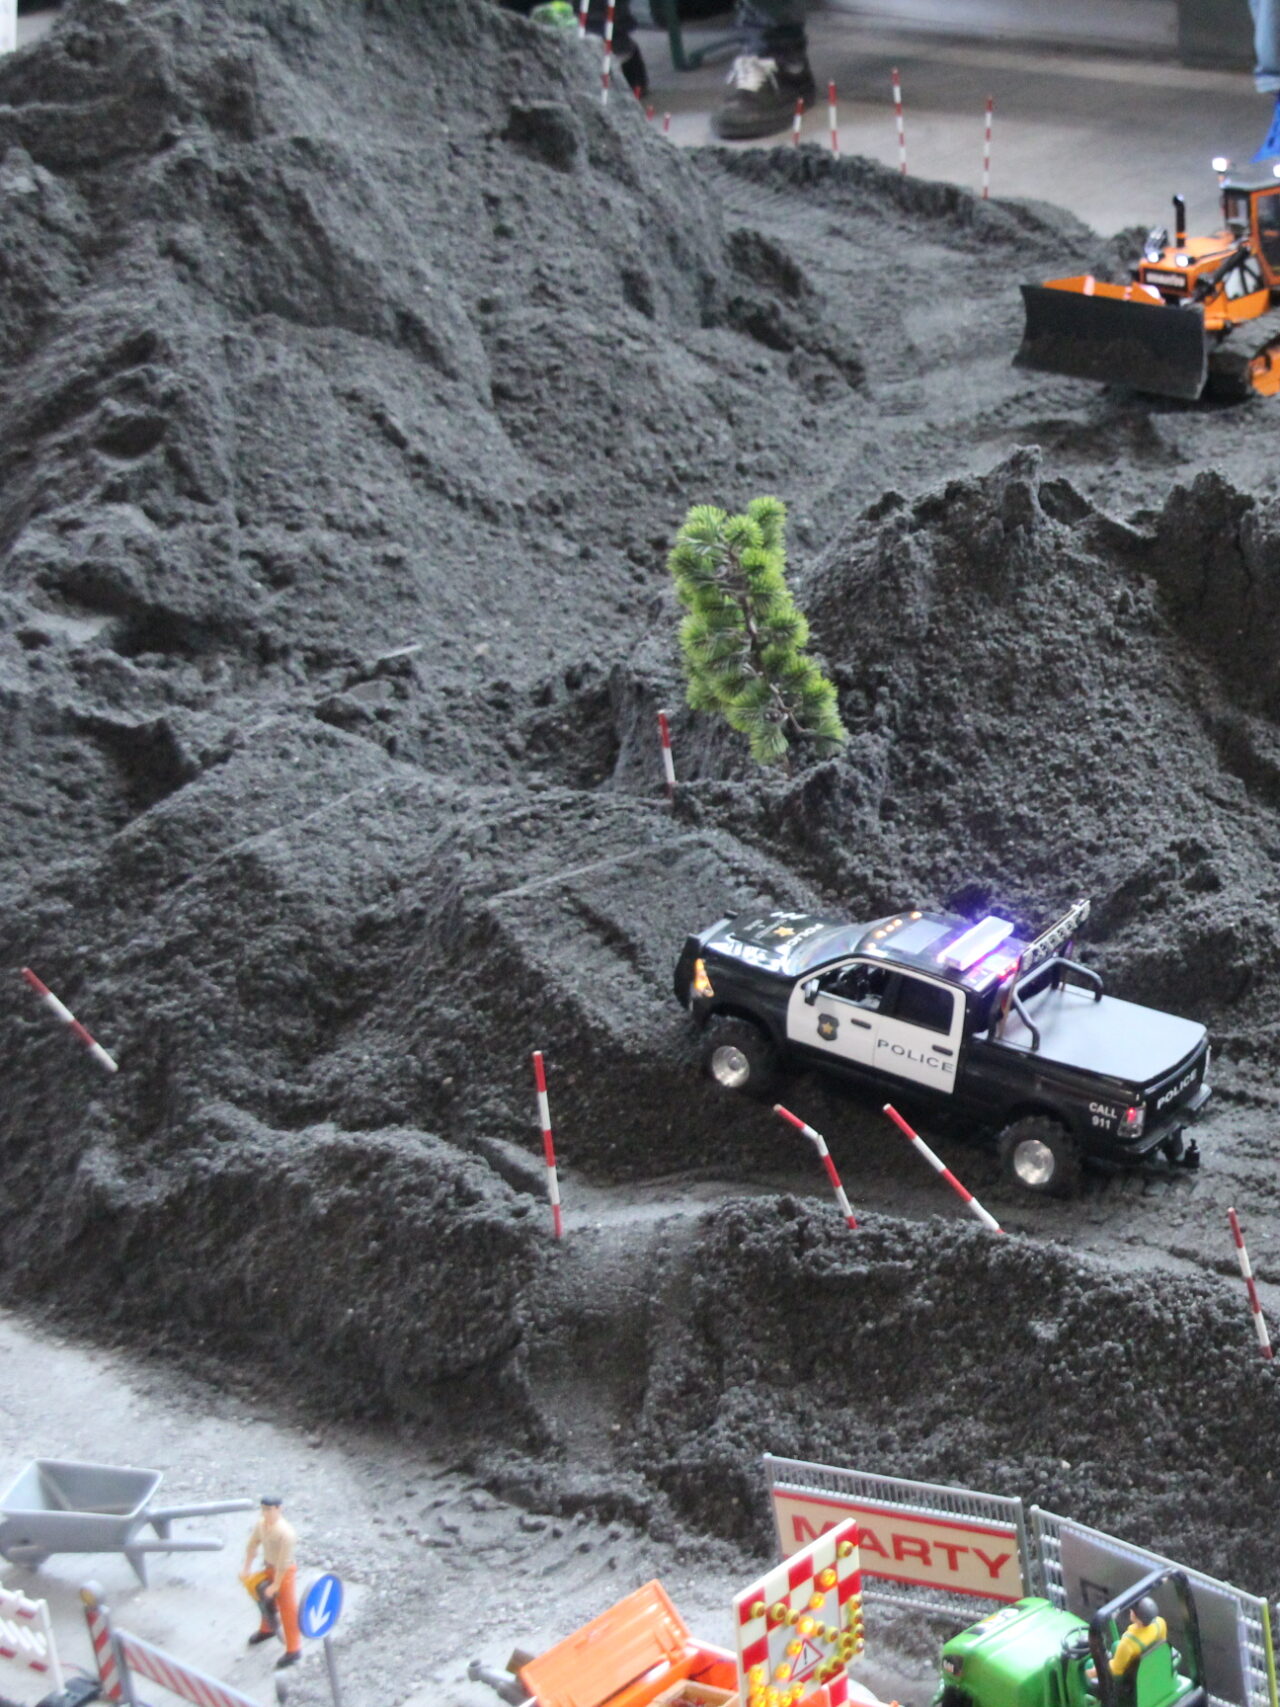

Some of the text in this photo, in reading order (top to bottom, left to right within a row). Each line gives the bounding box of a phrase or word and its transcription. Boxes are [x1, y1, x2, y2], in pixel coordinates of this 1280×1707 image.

[877, 1039, 954, 1074] POLICE
[1156, 1068, 1198, 1110] POLICE
[1089, 1102, 1118, 1119] CALL
[1092, 1115, 1111, 1130] 911
